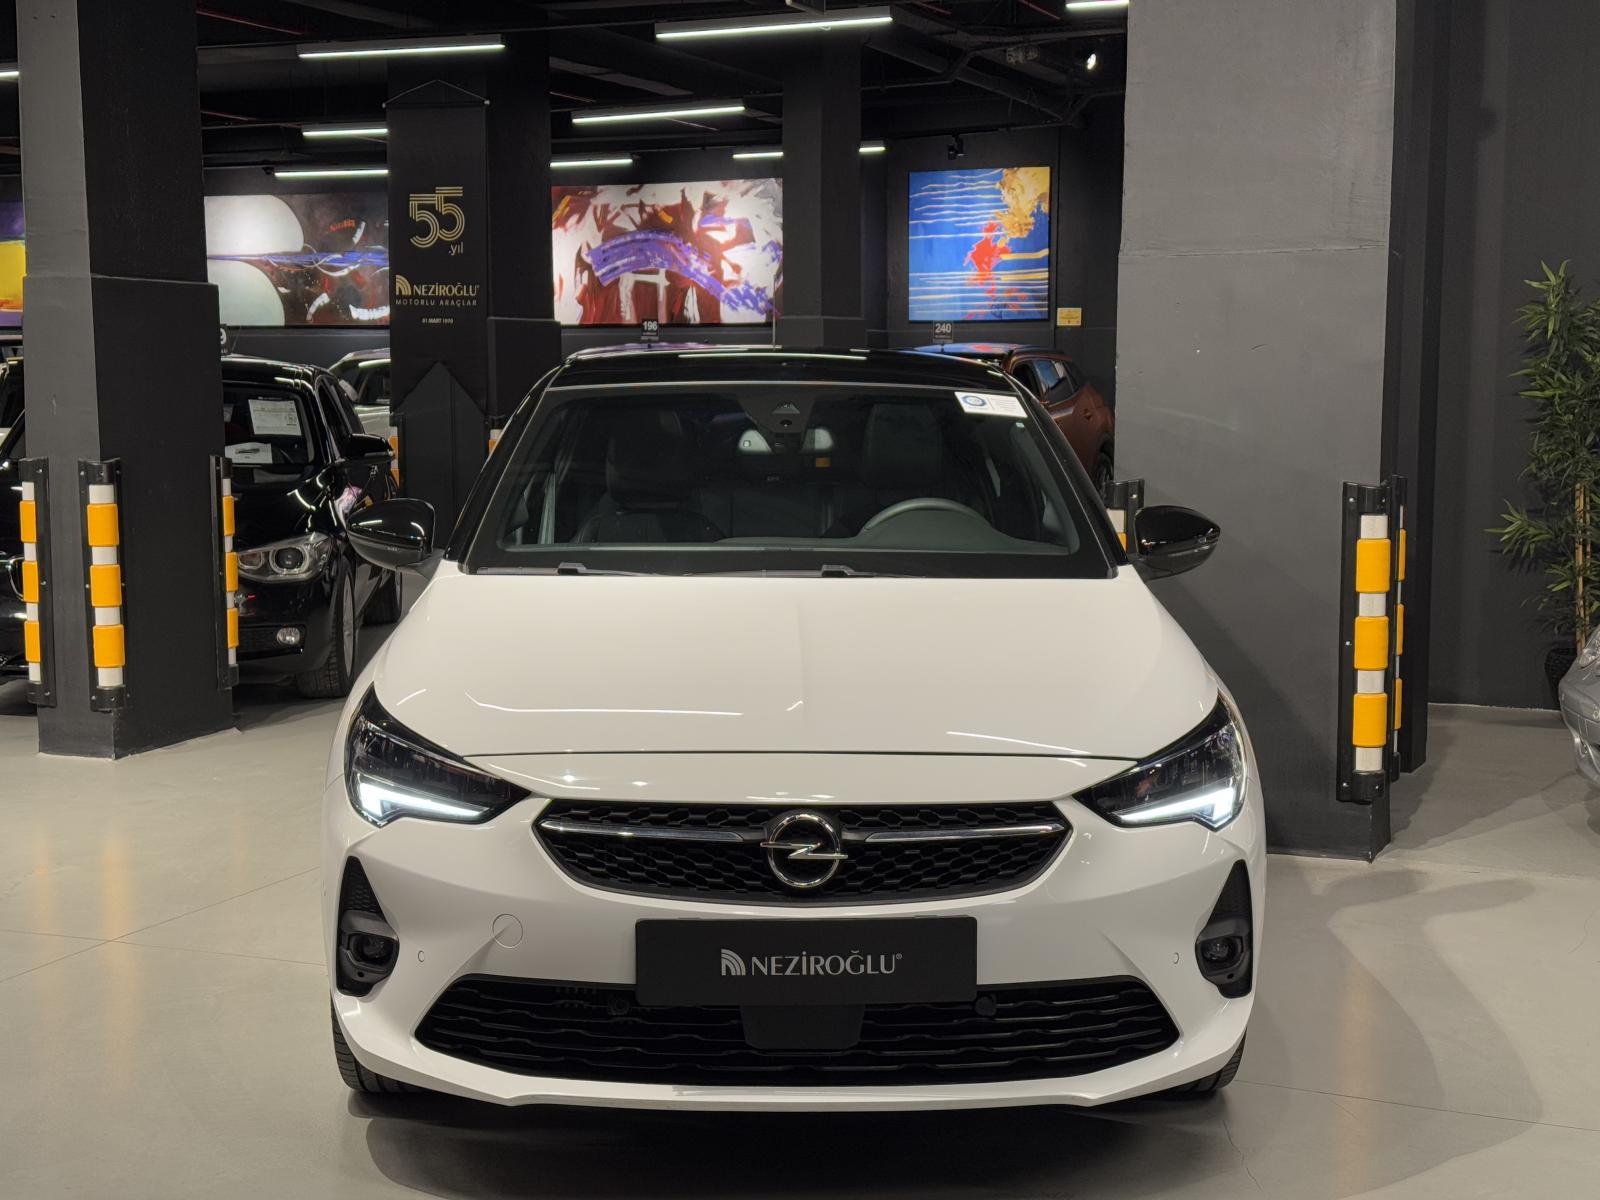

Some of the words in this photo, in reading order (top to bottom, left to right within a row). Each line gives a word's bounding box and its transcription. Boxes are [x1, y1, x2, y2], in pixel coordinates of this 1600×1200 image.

[409, 186, 465, 248] 55
[440, 299, 477, 308] ARAÇLAR
[642, 320, 658, 331] 196
[935, 322, 952, 333] 240
